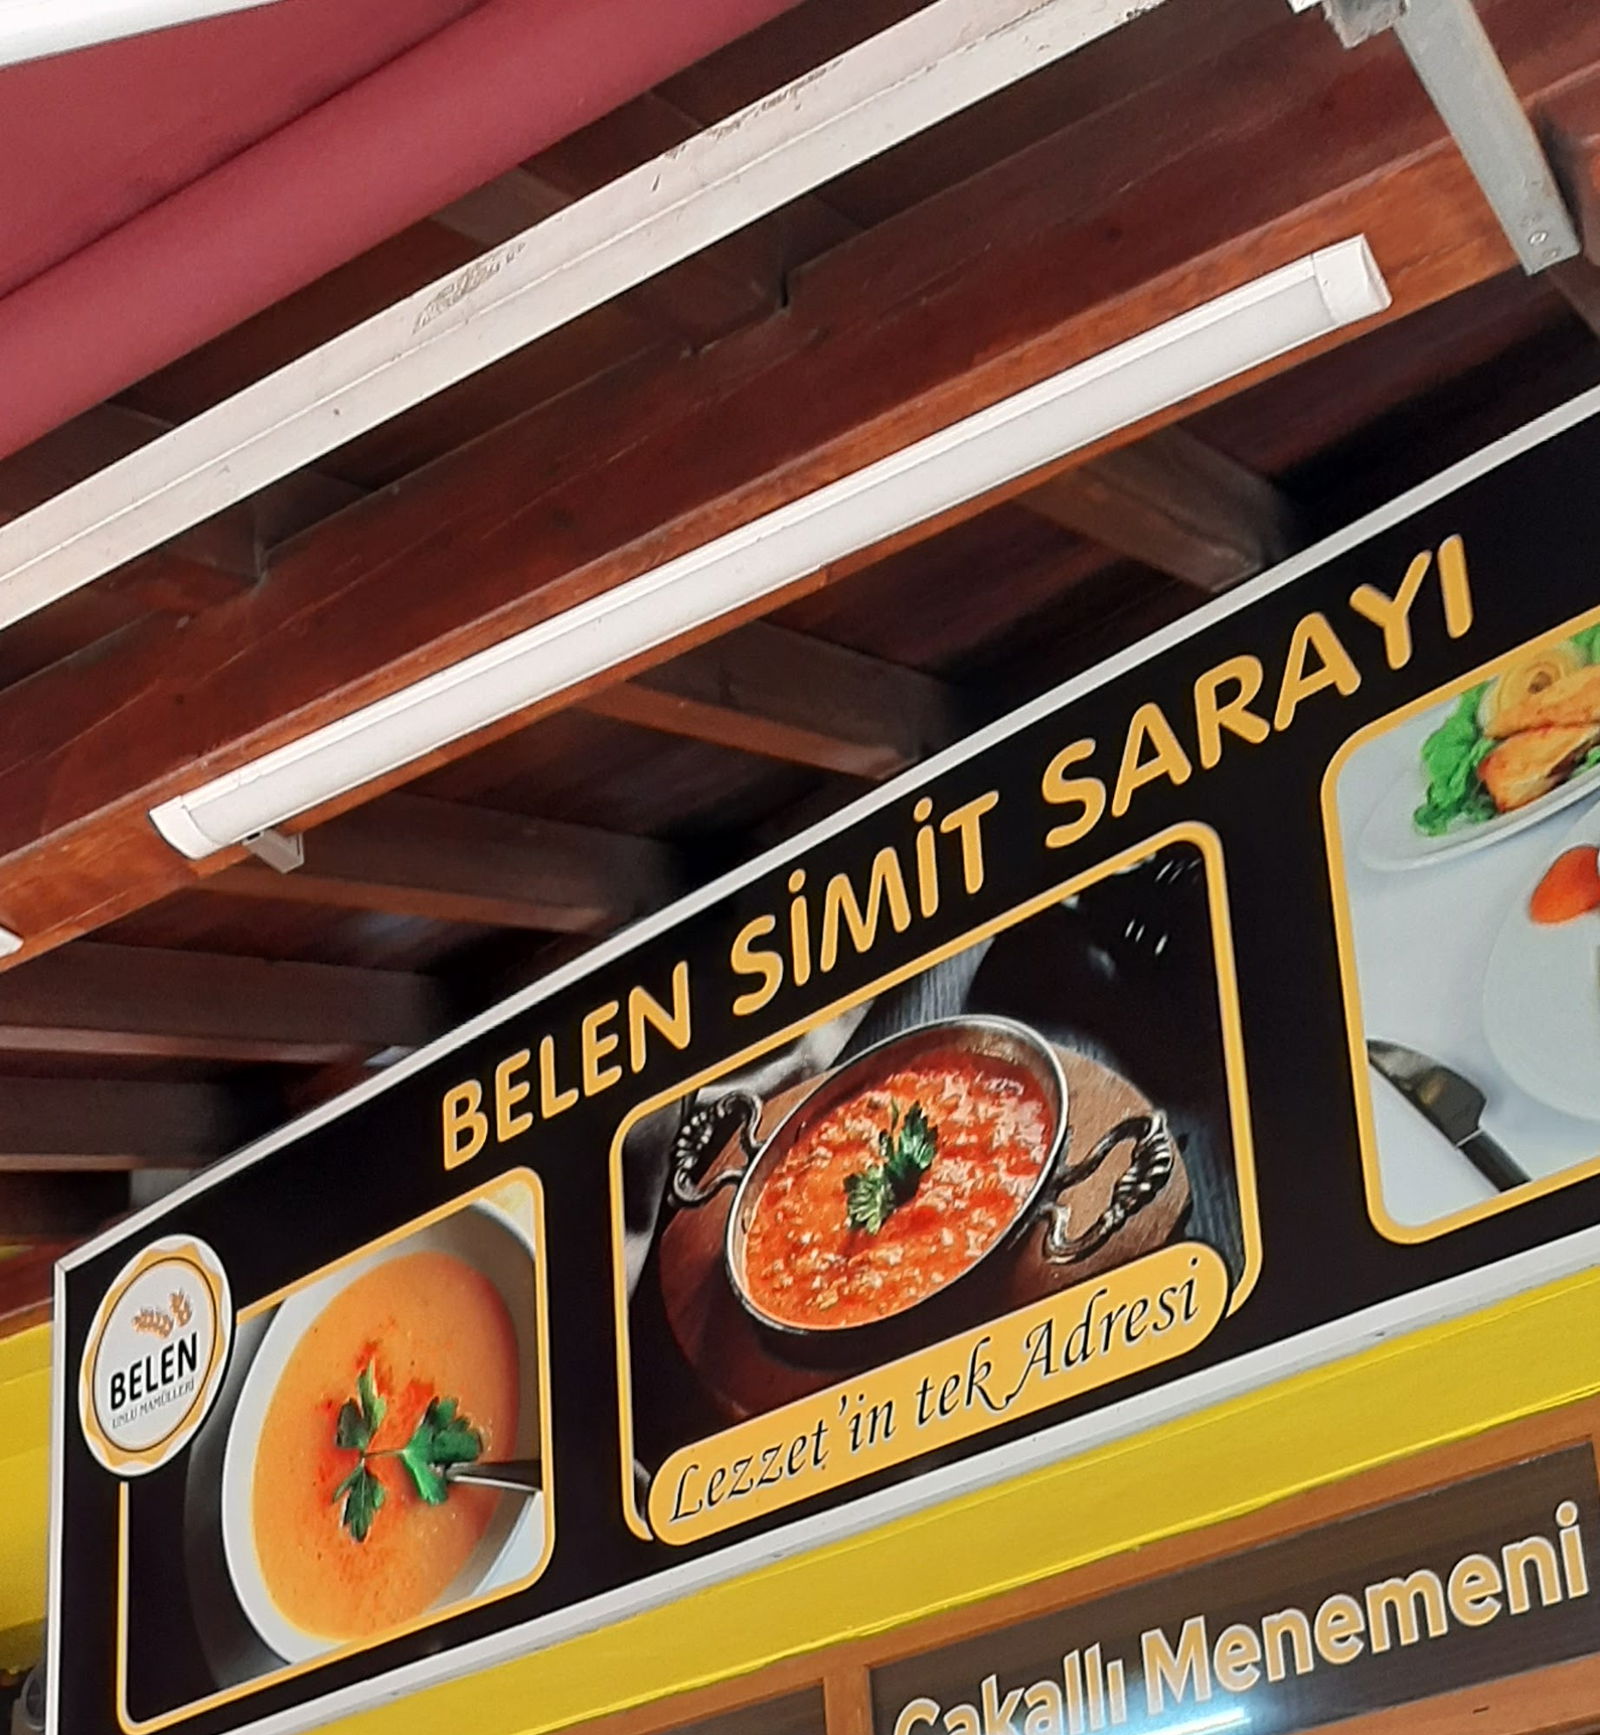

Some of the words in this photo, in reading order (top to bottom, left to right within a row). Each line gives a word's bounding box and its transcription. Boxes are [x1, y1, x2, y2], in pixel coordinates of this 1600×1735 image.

[442, 960, 691, 1171] BELEN
[730, 795, 1000, 1016] SİMİT
[1041, 534, 1474, 849] SARAYI
[110, 1331, 197, 1411] BELEN
[916, 1335, 1009, 1426] tek
[1006, 1257, 1201, 1407] Adresi
[1141, 1499, 1590, 1716] Menemeni
